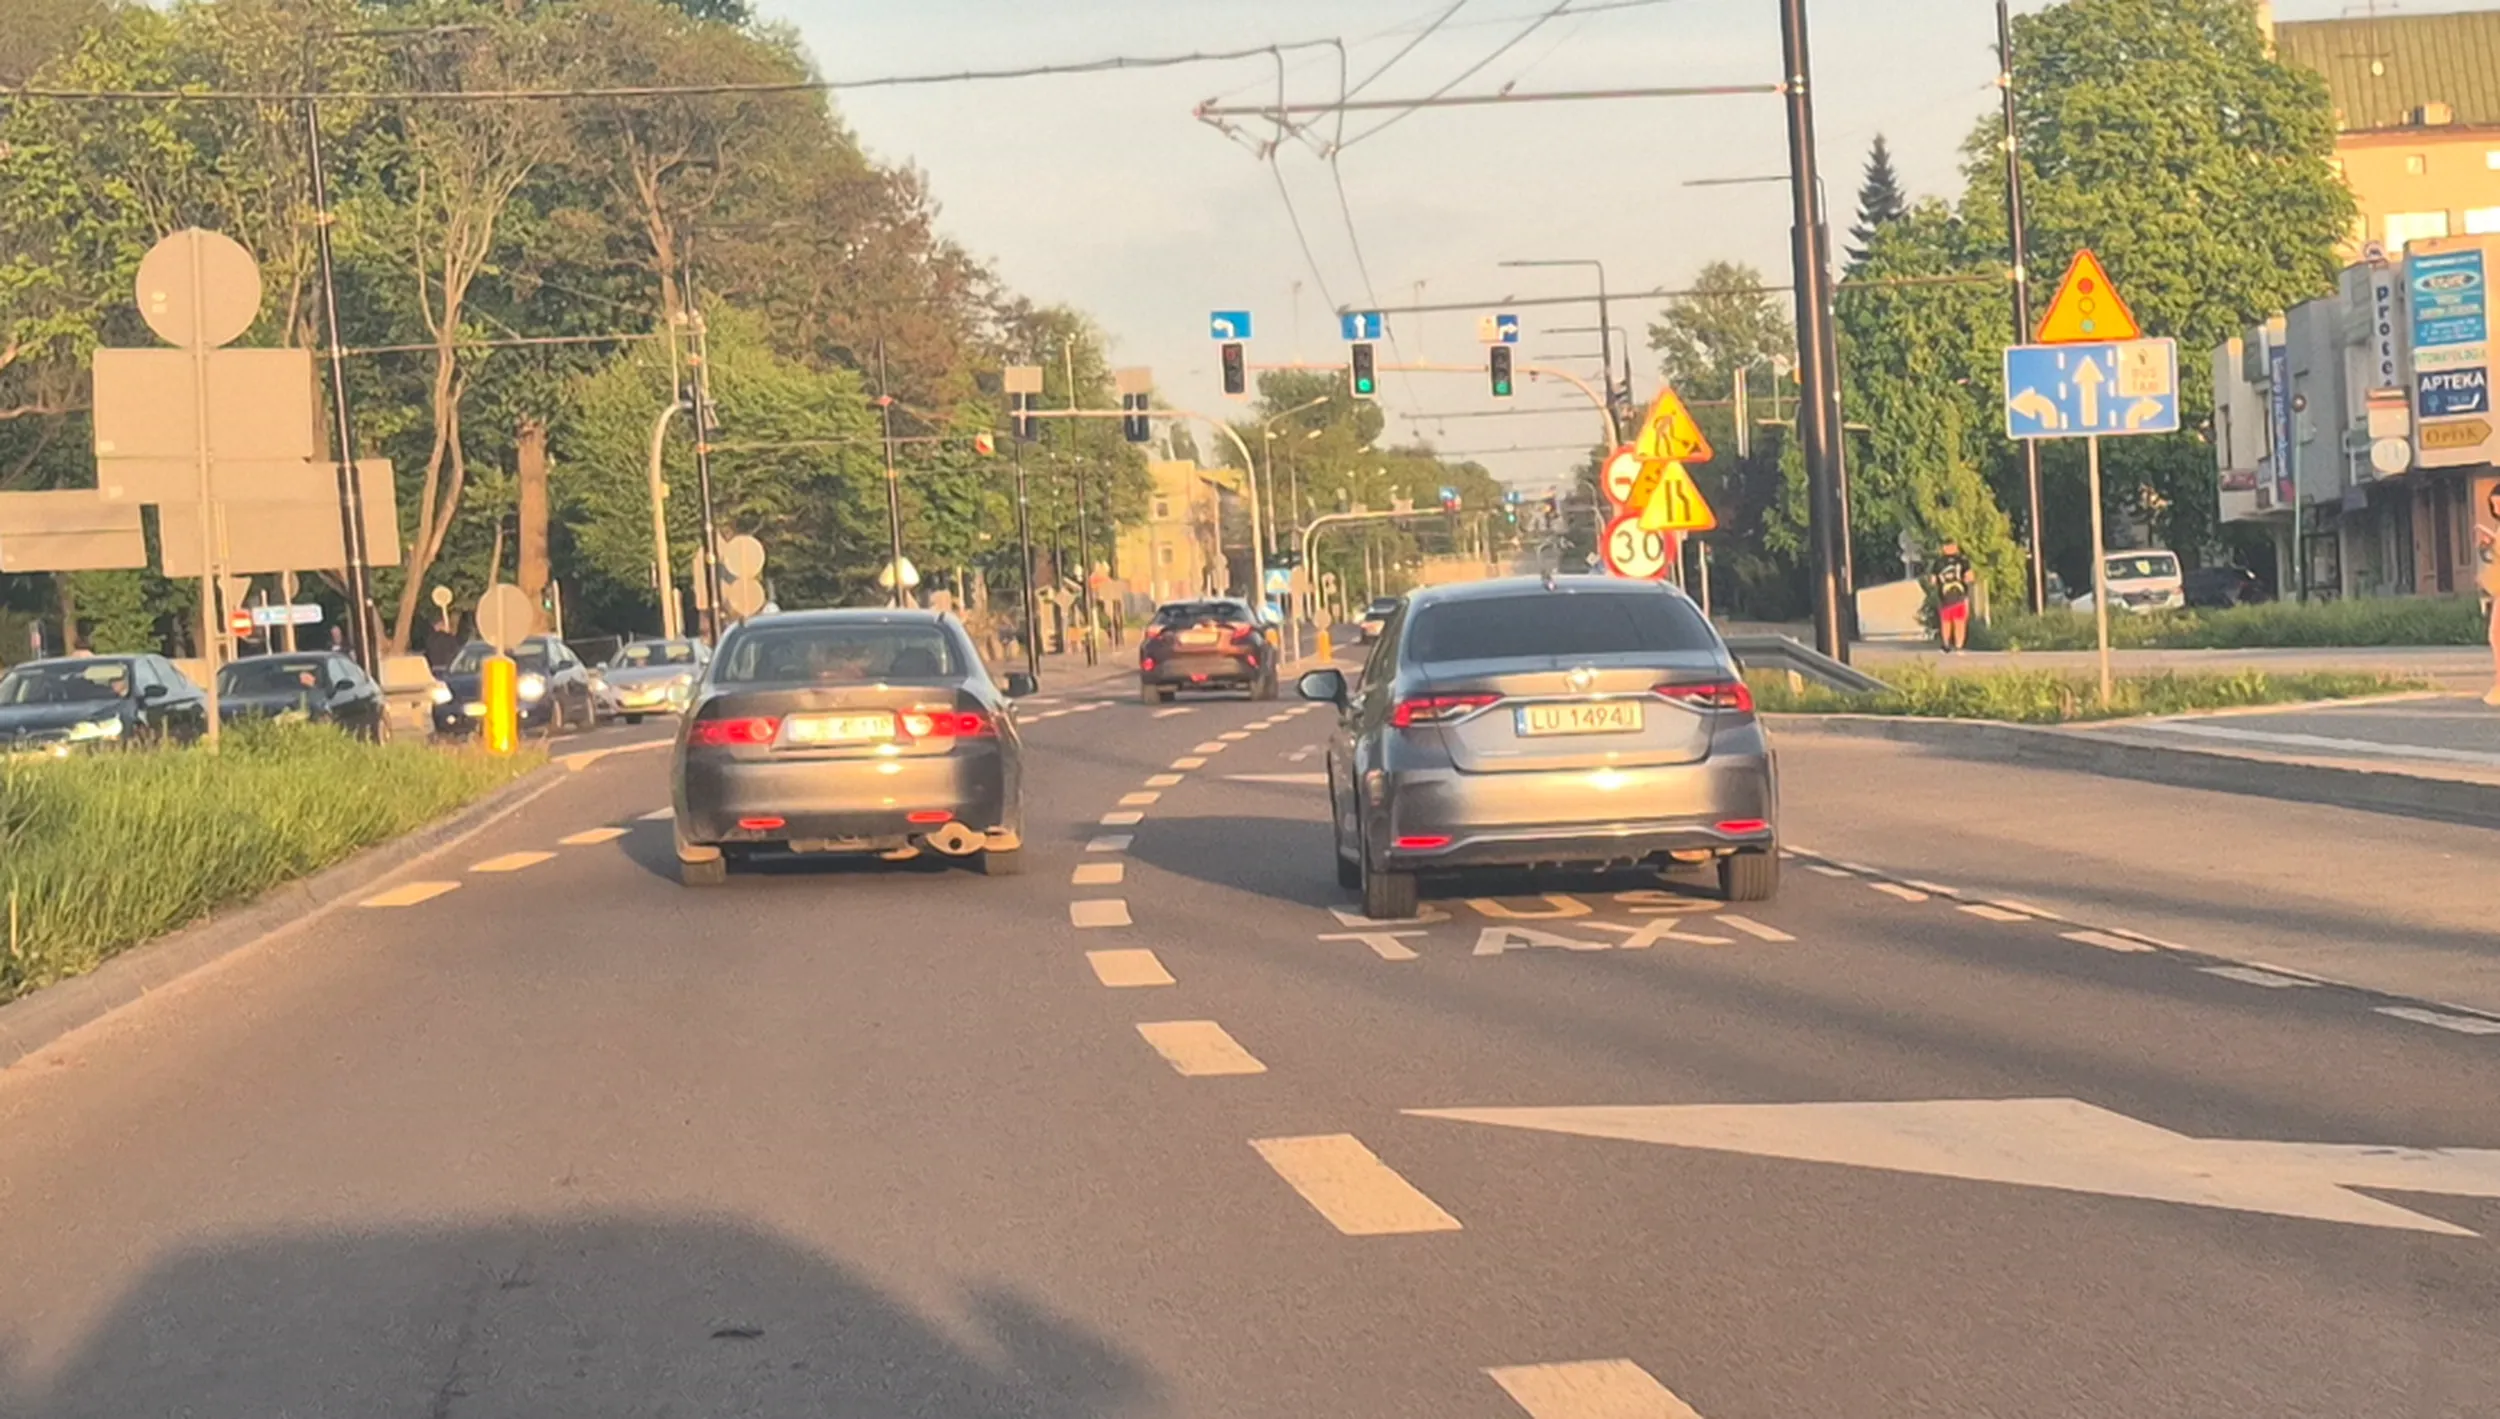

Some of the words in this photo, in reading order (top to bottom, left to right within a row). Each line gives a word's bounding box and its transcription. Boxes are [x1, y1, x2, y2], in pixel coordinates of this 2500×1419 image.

[2420, 371, 2485, 392] APTEKA
[1616, 530, 1664, 564] 30
[1531, 709, 1560, 730] LU
[1317, 915, 1797, 960] TAXI
